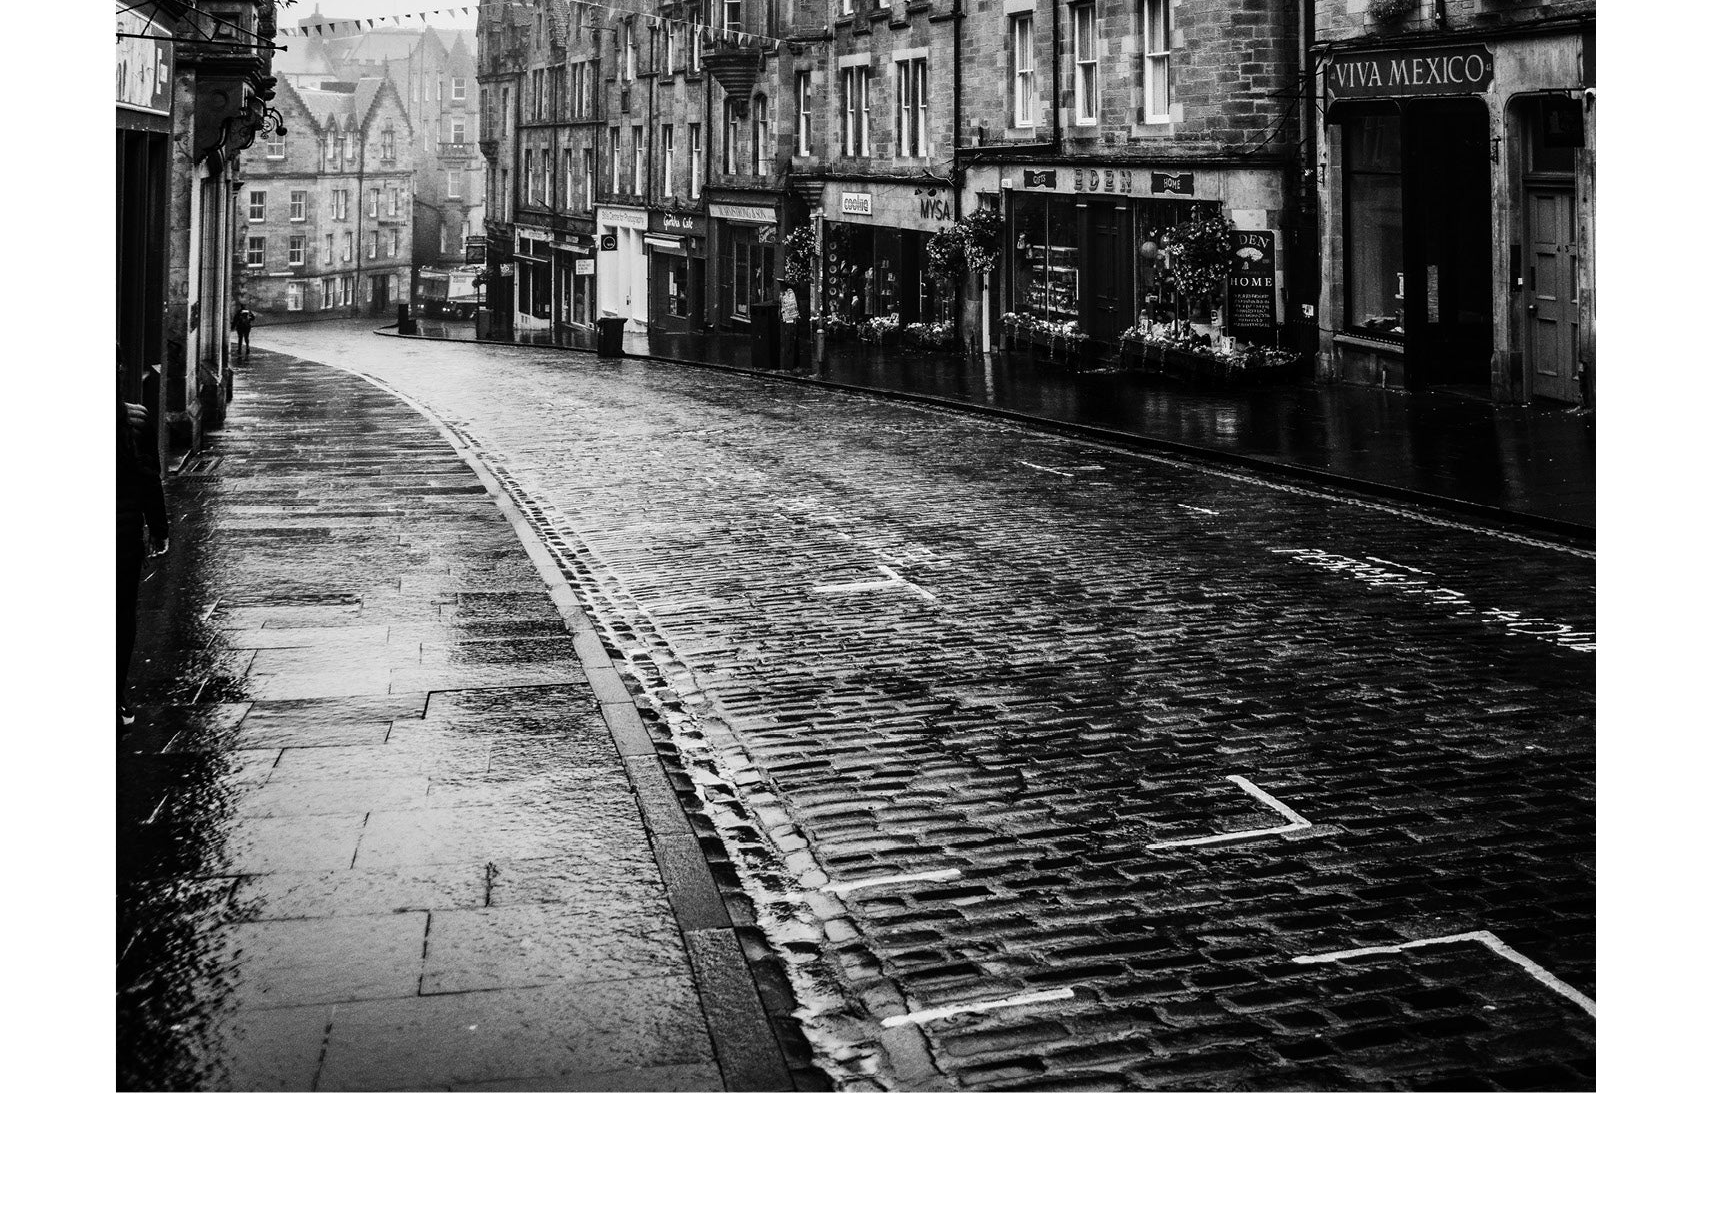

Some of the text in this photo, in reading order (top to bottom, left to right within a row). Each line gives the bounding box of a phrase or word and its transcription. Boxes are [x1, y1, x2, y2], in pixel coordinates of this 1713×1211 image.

[1334, 54, 1484, 88] VIVA MEXICO
[1074, 169, 1132, 193] EDEN
[1163, 177, 1181, 190] HOME
[920, 198, 951, 222] MYSA
[1239, 234, 1270, 248] DEN
[1230, 277, 1273, 287] HOME
